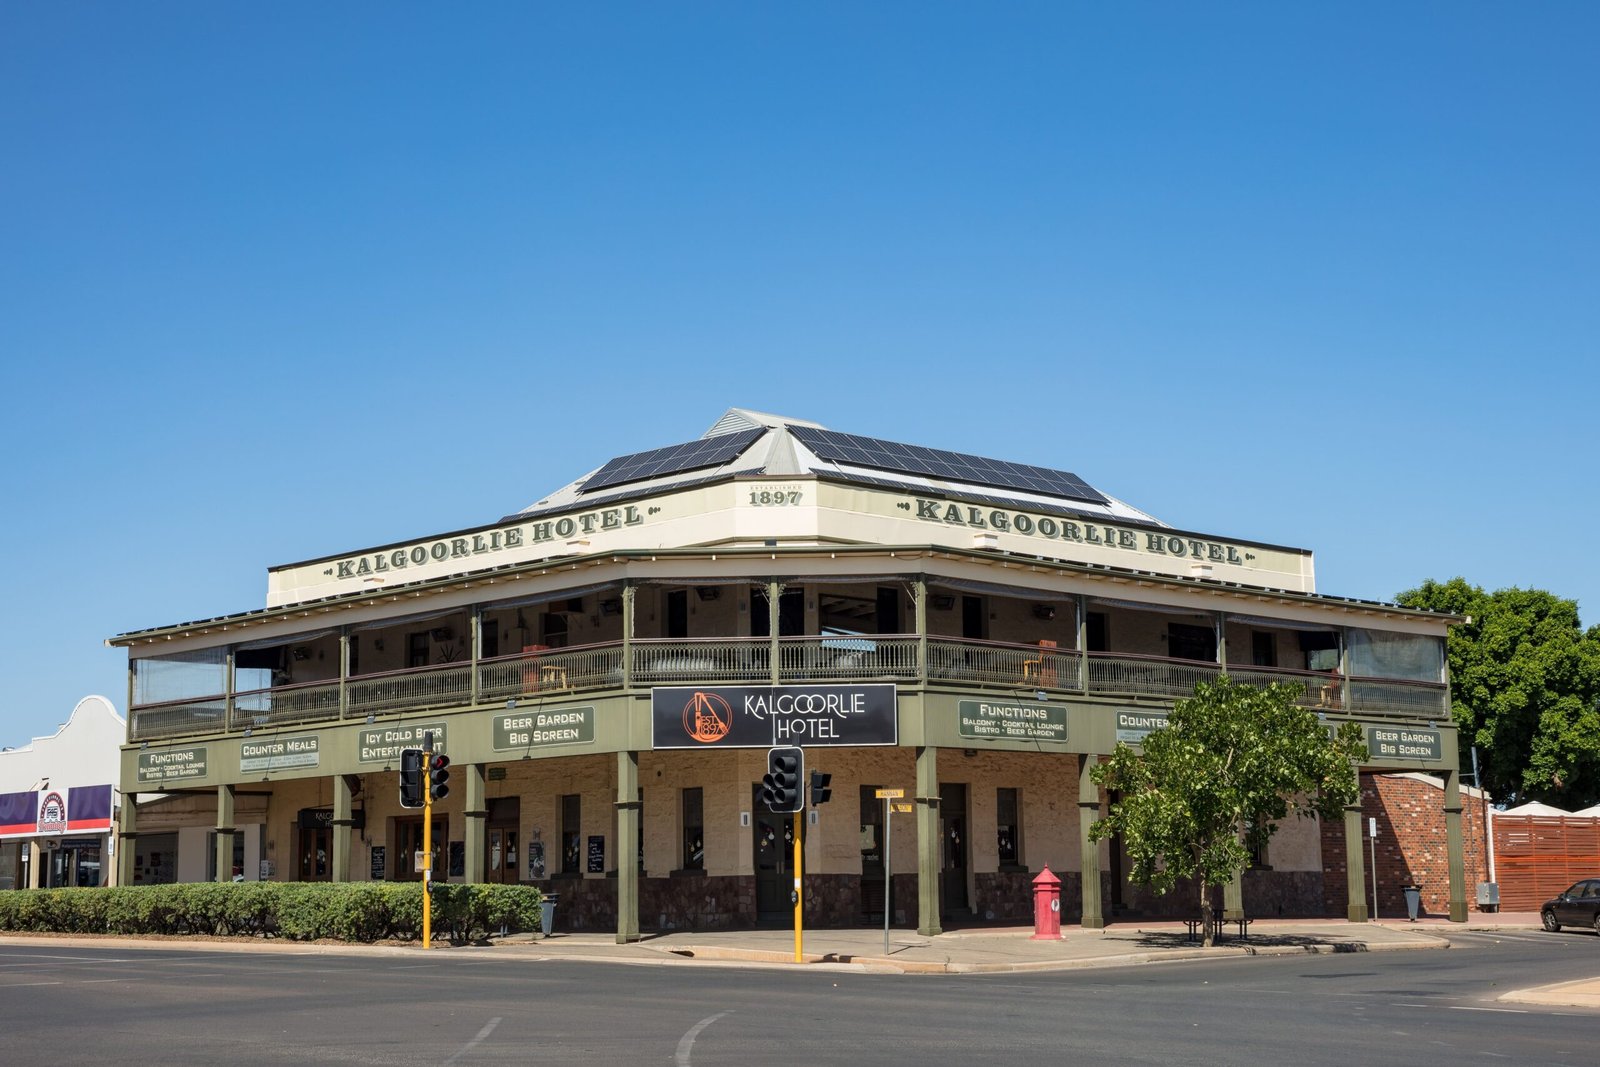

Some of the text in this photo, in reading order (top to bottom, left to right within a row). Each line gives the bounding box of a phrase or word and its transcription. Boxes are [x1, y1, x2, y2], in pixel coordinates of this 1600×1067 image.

[749, 491, 802, 506] 1897
[916, 498, 1242, 564] KALGOORLIE HOTEL
[337, 505, 643, 579] KALGOORLIE HOTEL
[744, 694, 865, 738] KALGOORLIE HOTEL
[980, 704, 1048, 719] FUNCTIONS
[503, 712, 585, 731] BEER GARDEN
[963, 718, 1065, 731] BALCONY COCKTAIL LOUNGE
[1120, 714, 1169, 728] COUNTER
[366, 733, 381, 745] ICY
[385, 731, 413, 742] COLD
[510, 728, 580, 745] BIG SCREEN
[974, 725, 1055, 737] BISTRO BEER GARDEN
[1375, 731, 1435, 744] BEER GARDEN
[243, 740, 317, 756] COUNTER MEALS
[1380, 743, 1432, 756] BIG SCREEN
[150, 752, 194, 764] FUNCTIONS
